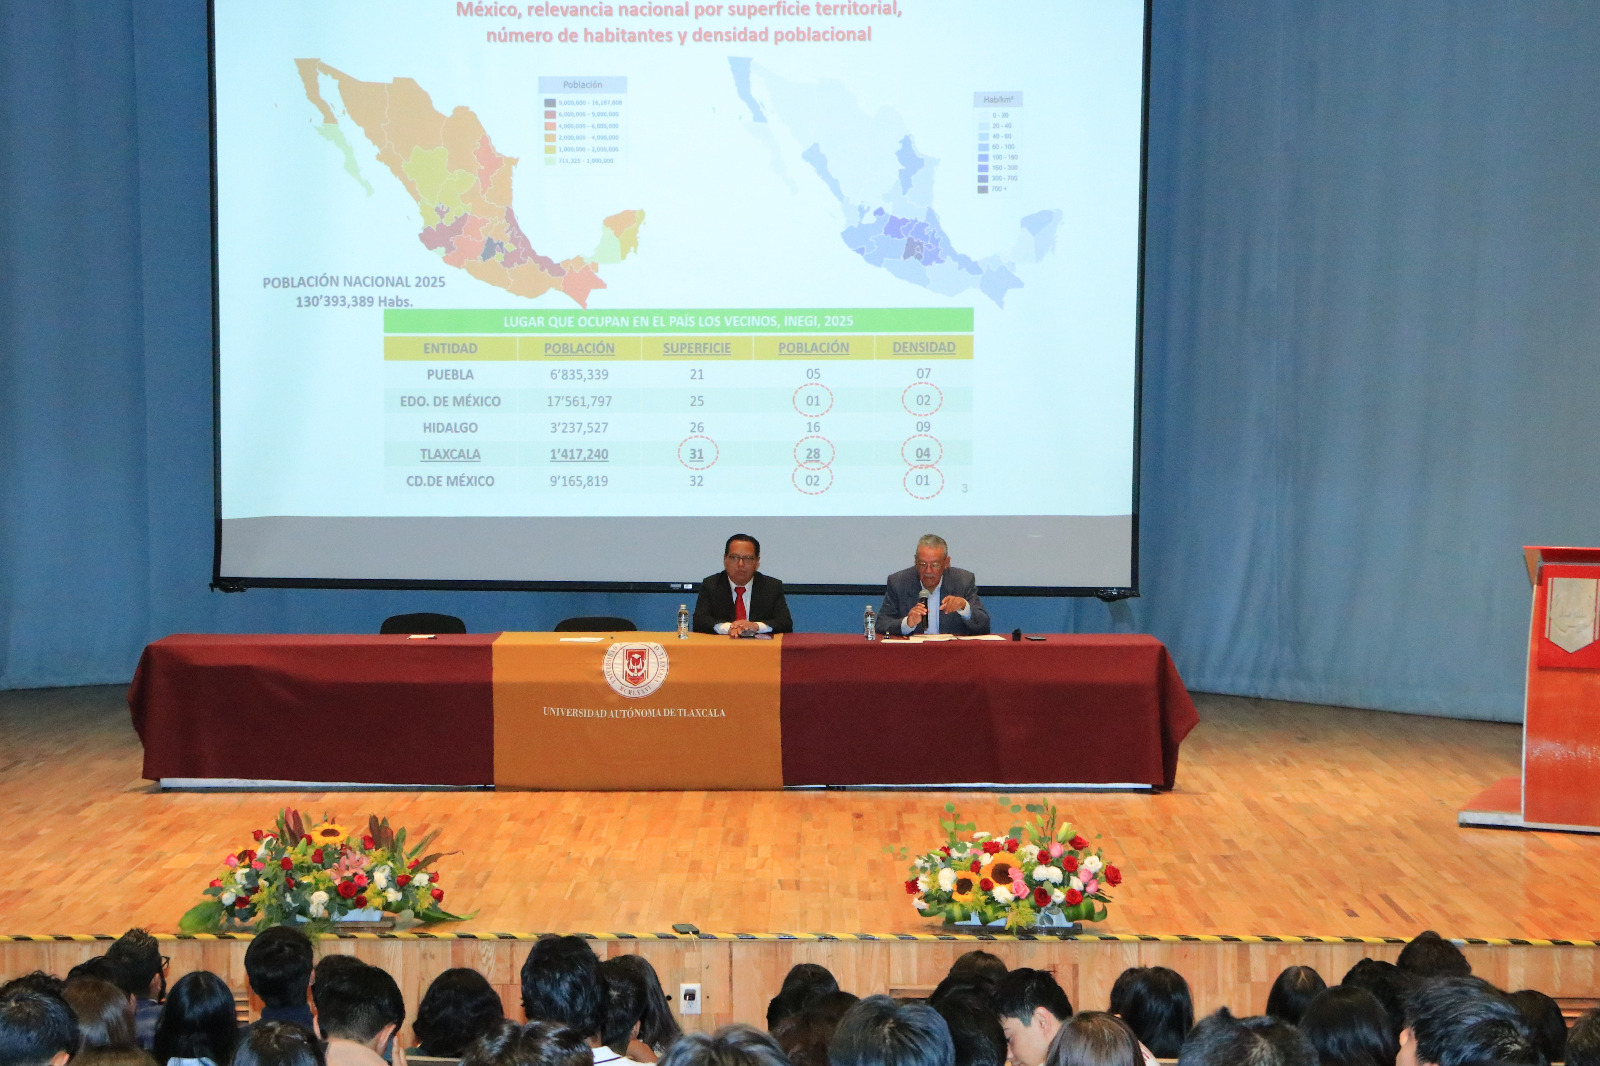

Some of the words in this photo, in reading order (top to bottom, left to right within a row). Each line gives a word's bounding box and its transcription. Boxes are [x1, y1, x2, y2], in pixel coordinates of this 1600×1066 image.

[456, 0, 522, 18] México,
[528, 1, 613, 17] relevancia
[619, 1, 689, 17] nacional
[695, 5, 723, 20] por
[728, 0, 810, 19] superficie
[815, 0, 902, 18] territorial,
[487, 27, 553, 43] número
[558, 28, 578, 43] de
[584, 27, 673, 43] habitantes
[678, 31, 687, 46] y
[692, 27, 769, 42] densidad
[774, 26, 871, 45] poblacional
[263, 273, 339, 288] POBLACIÓN
[344, 276, 411, 287] NACIONAL
[415, 276, 445, 287] 2025
[378, 295, 413, 309] Habs.
[504, 316, 545, 327] LUGAR
[548, 316, 574, 328] QUE
[578, 316, 629, 327] OCUPAN
[633, 316, 649, 327] EN
[653, 316, 666, 327] EL
[669, 314, 695, 327] PAÍS
[699, 316, 721, 327] LOS
[724, 316, 781, 330] VECINOS,
[784, 316, 821, 330] INEGI,
[824, 316, 853, 327] 2025
[424, 343, 478, 354] ENTIDAD
[544, 340, 615, 356] POBLACIÓN
[663, 342, 731, 356] SUPERFICIE
[778, 339, 850, 356] POBLACIÓN
[893, 342, 956, 355] DENSIDAD
[428, 369, 474, 380] PUEBLA
[690, 369, 704, 379] 21
[807, 368, 820, 379] 05
[917, 368, 931, 379] 07
[400, 396, 429, 407] EDO.
[433, 396, 449, 407] DE
[453, 394, 501, 407] MÉXICO
[690, 396, 704, 406] 25
[806, 395, 820, 406] 01
[917, 395, 930, 406] 02
[423, 422, 478, 433] HIDALGO
[690, 422, 704, 433] 26
[807, 422, 820, 433] 16
[916, 421, 931, 432] 09
[420, 449, 481, 462] TLAXCALA
[689, 449, 704, 462] 31
[806, 448, 820, 461] 28
[916, 448, 931, 461] 04
[447, 473, 494, 486] MÉXICO
[690, 476, 703, 486] 32
[806, 475, 820, 486] 02
[916, 475, 930, 486] 01
[962, 483, 968, 493] 3
[543, 707, 607, 718] UNIVERSIDAD
[609, 707, 662, 718] AUTÓNOMA
[664, 708, 676, 717] DE
[678, 708, 726, 717] TLAXCALA
